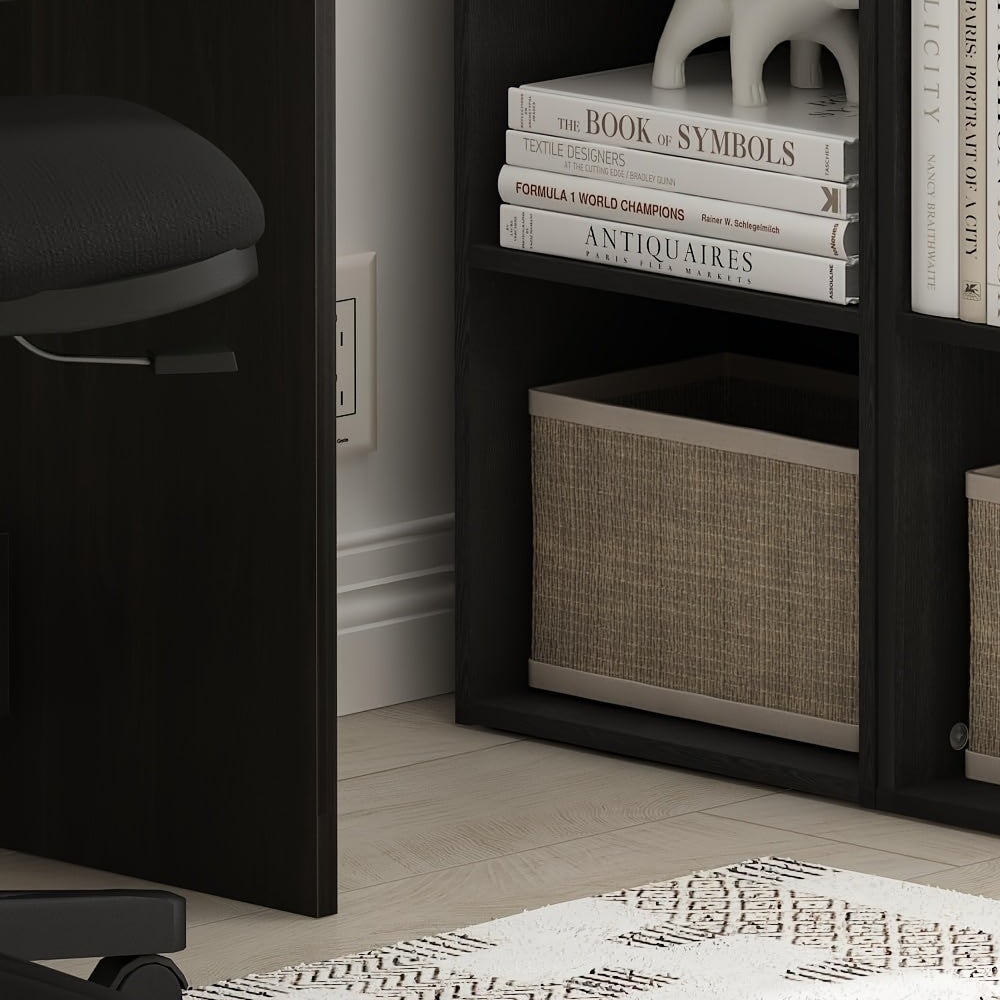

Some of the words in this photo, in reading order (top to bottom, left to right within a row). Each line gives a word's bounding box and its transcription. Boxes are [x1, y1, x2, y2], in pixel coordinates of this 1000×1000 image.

[965, 0, 977, 59] PARIS:
[965, 65, 977, 162] PORTRAIT
[522, 137, 564, 158] TEXTILE
[567, 144, 626, 168] DESIGNERS
[557, 117, 581, 133] THE
[586, 109, 653, 145] BOOK
[657, 133, 672, 147] OF
[677, 123, 796, 167] SYMBOLS
[563, 161, 572, 170] AT
[573, 162, 584, 172] THE
[584, 164, 609, 176] CUTTING
[610, 168, 625, 179] EDGE
[629, 170, 656, 183] BRADLEY
[926, 154, 936, 197] NANCY
[965, 167, 977, 192] OF
[515, 181, 567, 201] FORMULA
[570, 191, 576, 202] 1
[578, 191, 618, 210] WORLD
[620, 199, 686, 221] CHAMPIONS
[701, 213, 723, 225] Rainer
[724, 217, 733, 227] W.
[965, 196, 977, 209] A
[584, 225, 753, 274] ANTIQUAIRES
[926, 202, 937, 291] BRAITHWAITE
[965, 214, 977, 257] CITY
[684, 267, 754, 286] MARKETS
